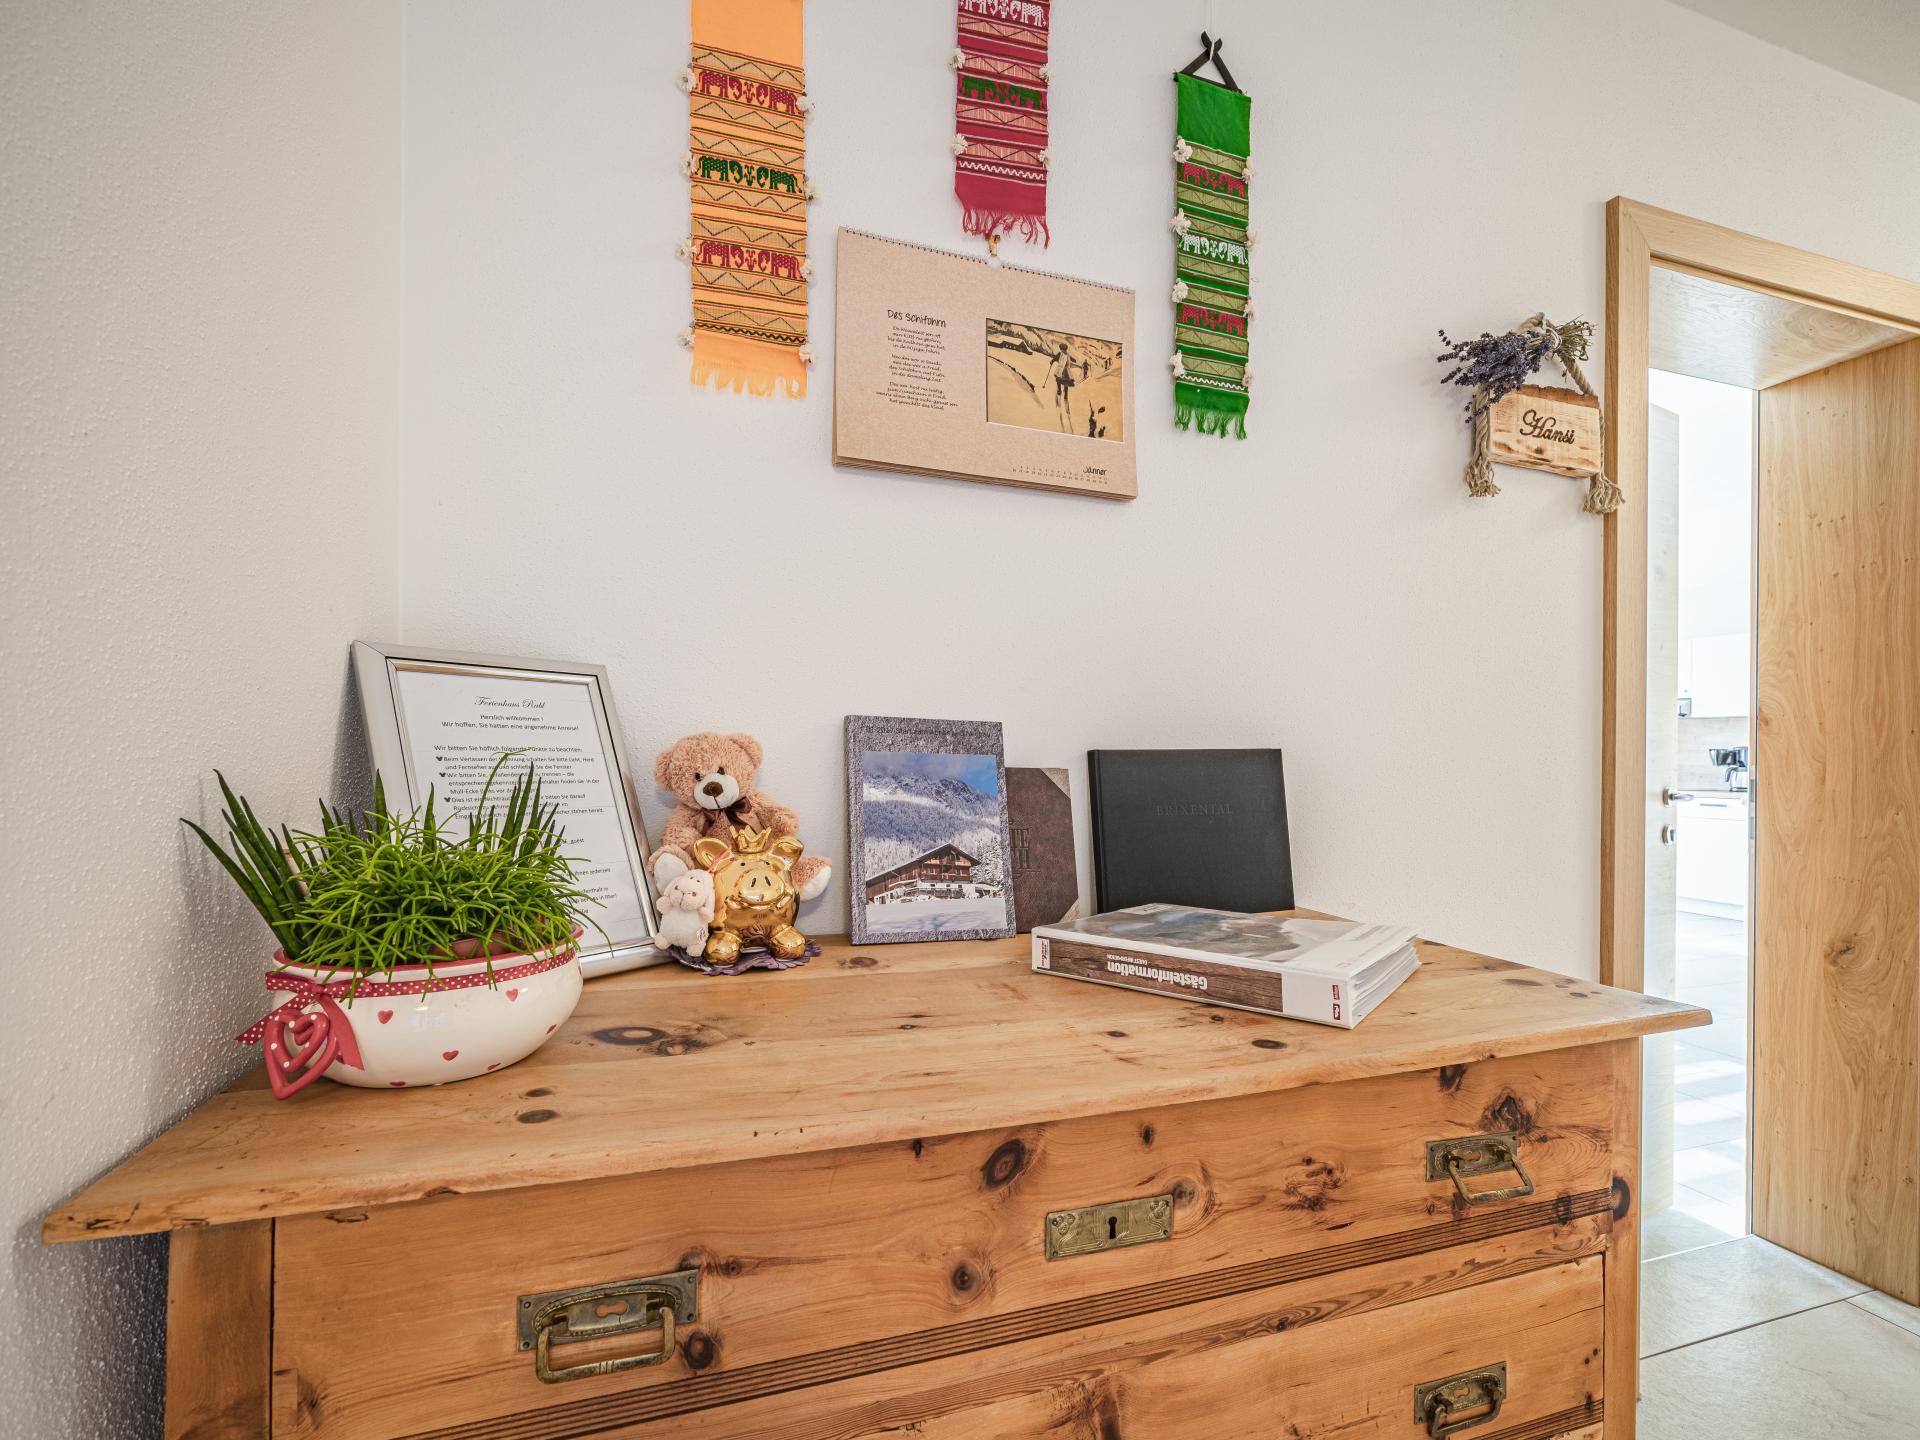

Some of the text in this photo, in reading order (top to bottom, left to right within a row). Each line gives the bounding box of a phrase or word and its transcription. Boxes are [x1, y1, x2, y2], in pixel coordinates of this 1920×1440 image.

[1520, 409, 1575, 445] Hansi
[474, 696, 520, 707] Ferienhaus
[1156, 803, 1233, 816] BRIXENTAL
[1107, 961, 1208, 990] Gästeinformation
